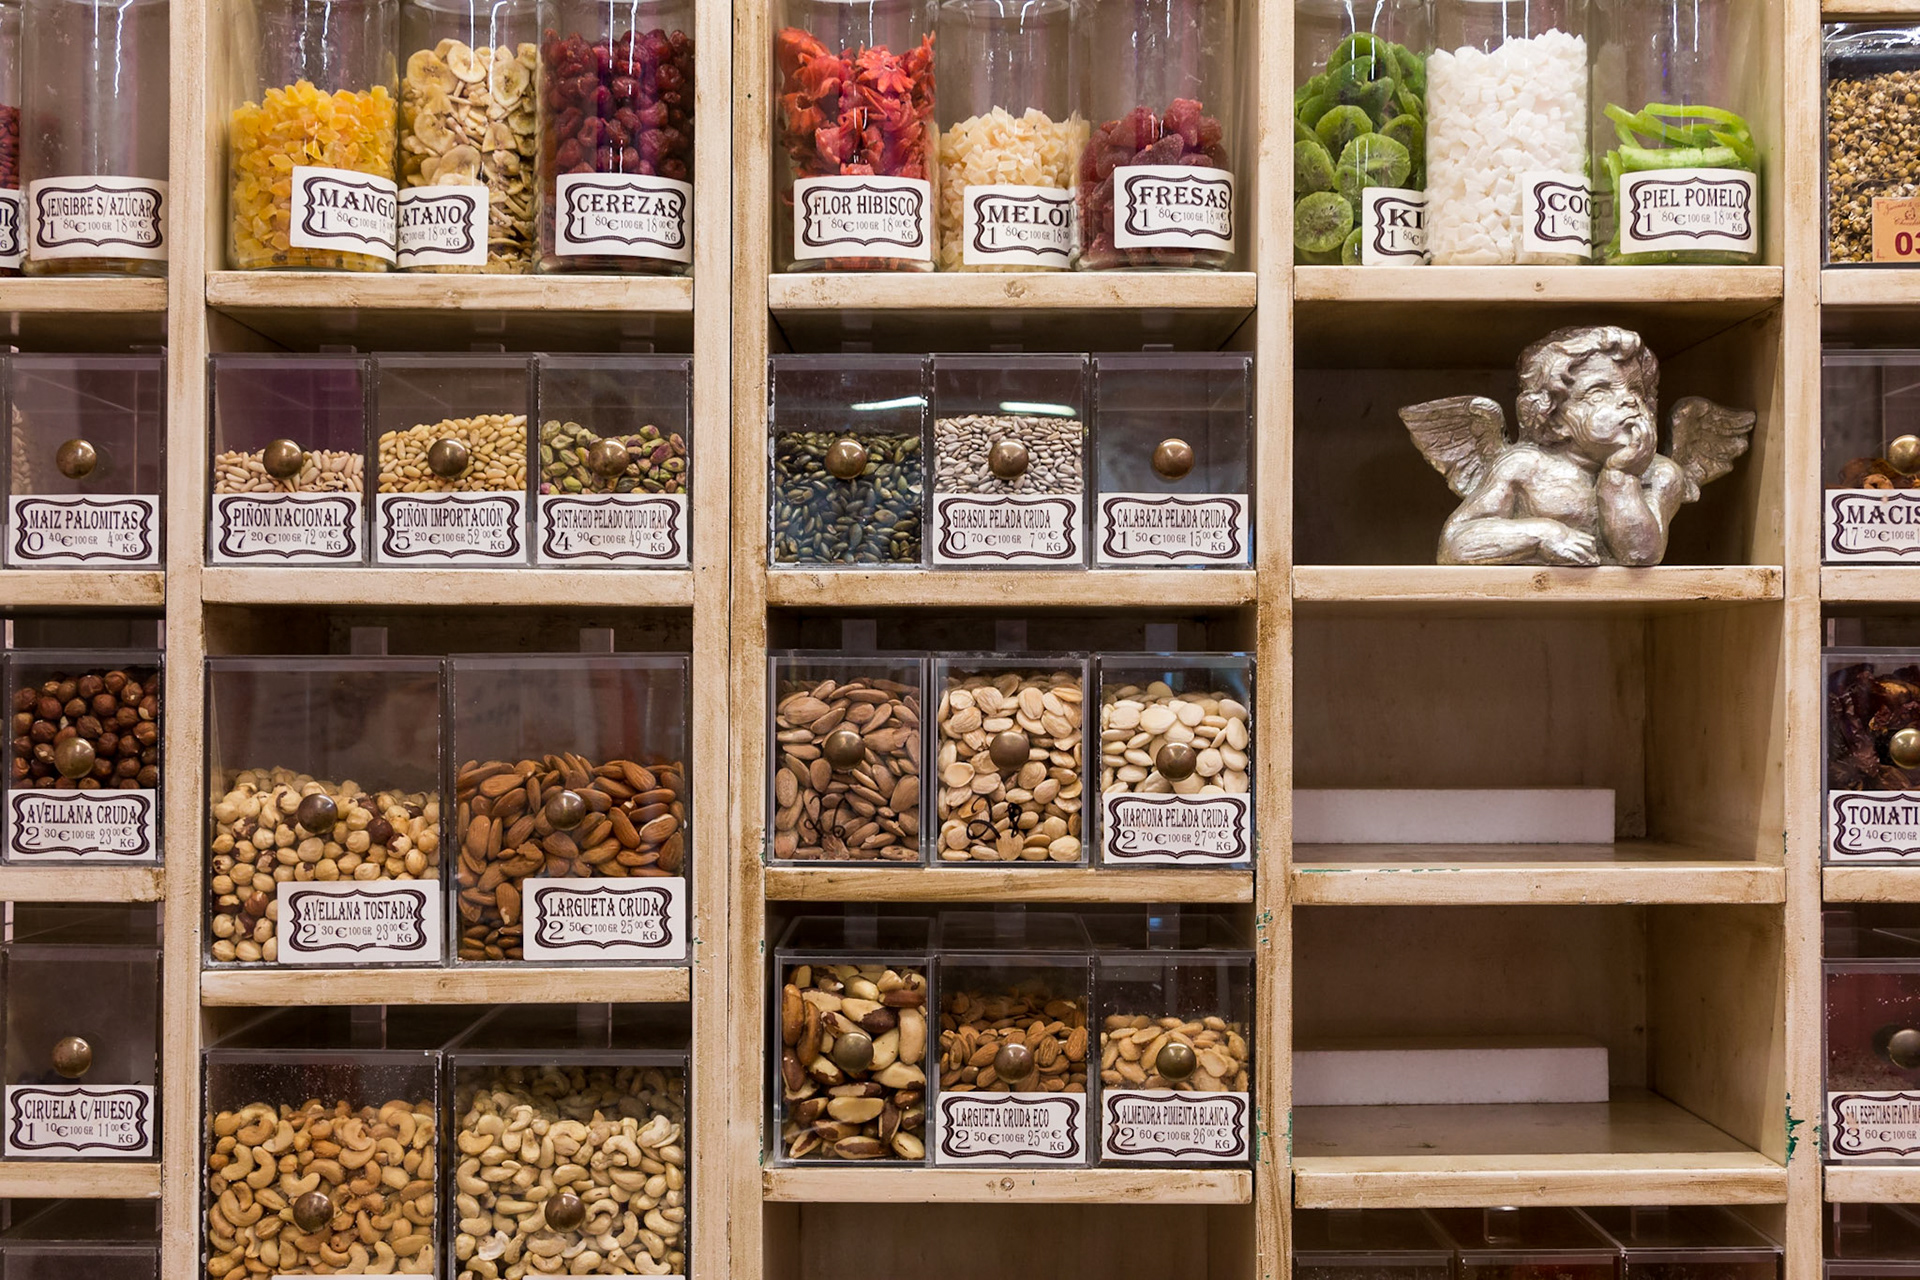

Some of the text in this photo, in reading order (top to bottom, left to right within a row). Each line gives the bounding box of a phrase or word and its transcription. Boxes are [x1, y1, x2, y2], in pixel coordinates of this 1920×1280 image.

[47, 197, 94, 218] JENGIBRE
[317, 188, 395, 220] MANGO
[577, 194, 677, 220] CEREZAS
[814, 195, 915, 217] FLOR HIBISCO
[1138, 186, 1228, 210] FRESAS
[1642, 188, 1744, 210] PIEL POMELO
[397, 206, 461, 228] ATANO
[1388, 208, 1424, 230] KI
[137, 230, 150, 241] KG
[665, 230, 677, 242] KG
[901, 229, 914, 241] KG
[1731, 222, 1743, 234] KG
[446, 237, 460, 247] KG
[29, 510, 139, 530] MAIZ PALOMITAS
[233, 503, 342, 527] PIÑÓN NACIONAL
[396, 503, 504, 527] PIÑÓN IMPORTACIÓN
[556, 509, 593, 529] PISTACHO
[594, 509, 623, 529] PELADO
[624, 509, 648, 530] CRUDO
[952, 509, 1051, 529] GIRASOL PELADA CRUDA
[1117, 509, 1227, 529] CALABAZA PELADA CRUDA
[124, 543, 139, 553] KG
[326, 541, 342, 550] KG
[490, 541, 505, 550] KG
[650, 543, 665, 552] KG
[1046, 542, 1061, 552] KG
[1211, 542, 1226, 551] KG
[26, 801, 138, 825] AVELLANA CRUDA
[1122, 808, 1229, 829] MARCONA PELADA CRUDA
[1847, 805, 1920, 825] TOMATI
[120, 838, 135, 848] KG
[1216, 841, 1231, 851] KG
[303, 899, 414, 921] AVELLANA TOSTADA
[549, 897, 660, 918] LARGUETA CRUDA
[397, 933, 412, 943] KG
[642, 931, 657, 941] KG
[25, 1098, 133, 1122] CIRUELA C/HUESO
[955, 1107, 1050, 1128] LARGUETA CRUDA ECO
[1121, 1105, 1230, 1127] ALMENDRA PIMIENTA BLANCA
[1860, 1105, 1891, 1125] ESPECIAS
[118, 1133, 133, 1144] KG
[1049, 1141, 1065, 1151] KG
[1215, 1139, 1230, 1149] KG
